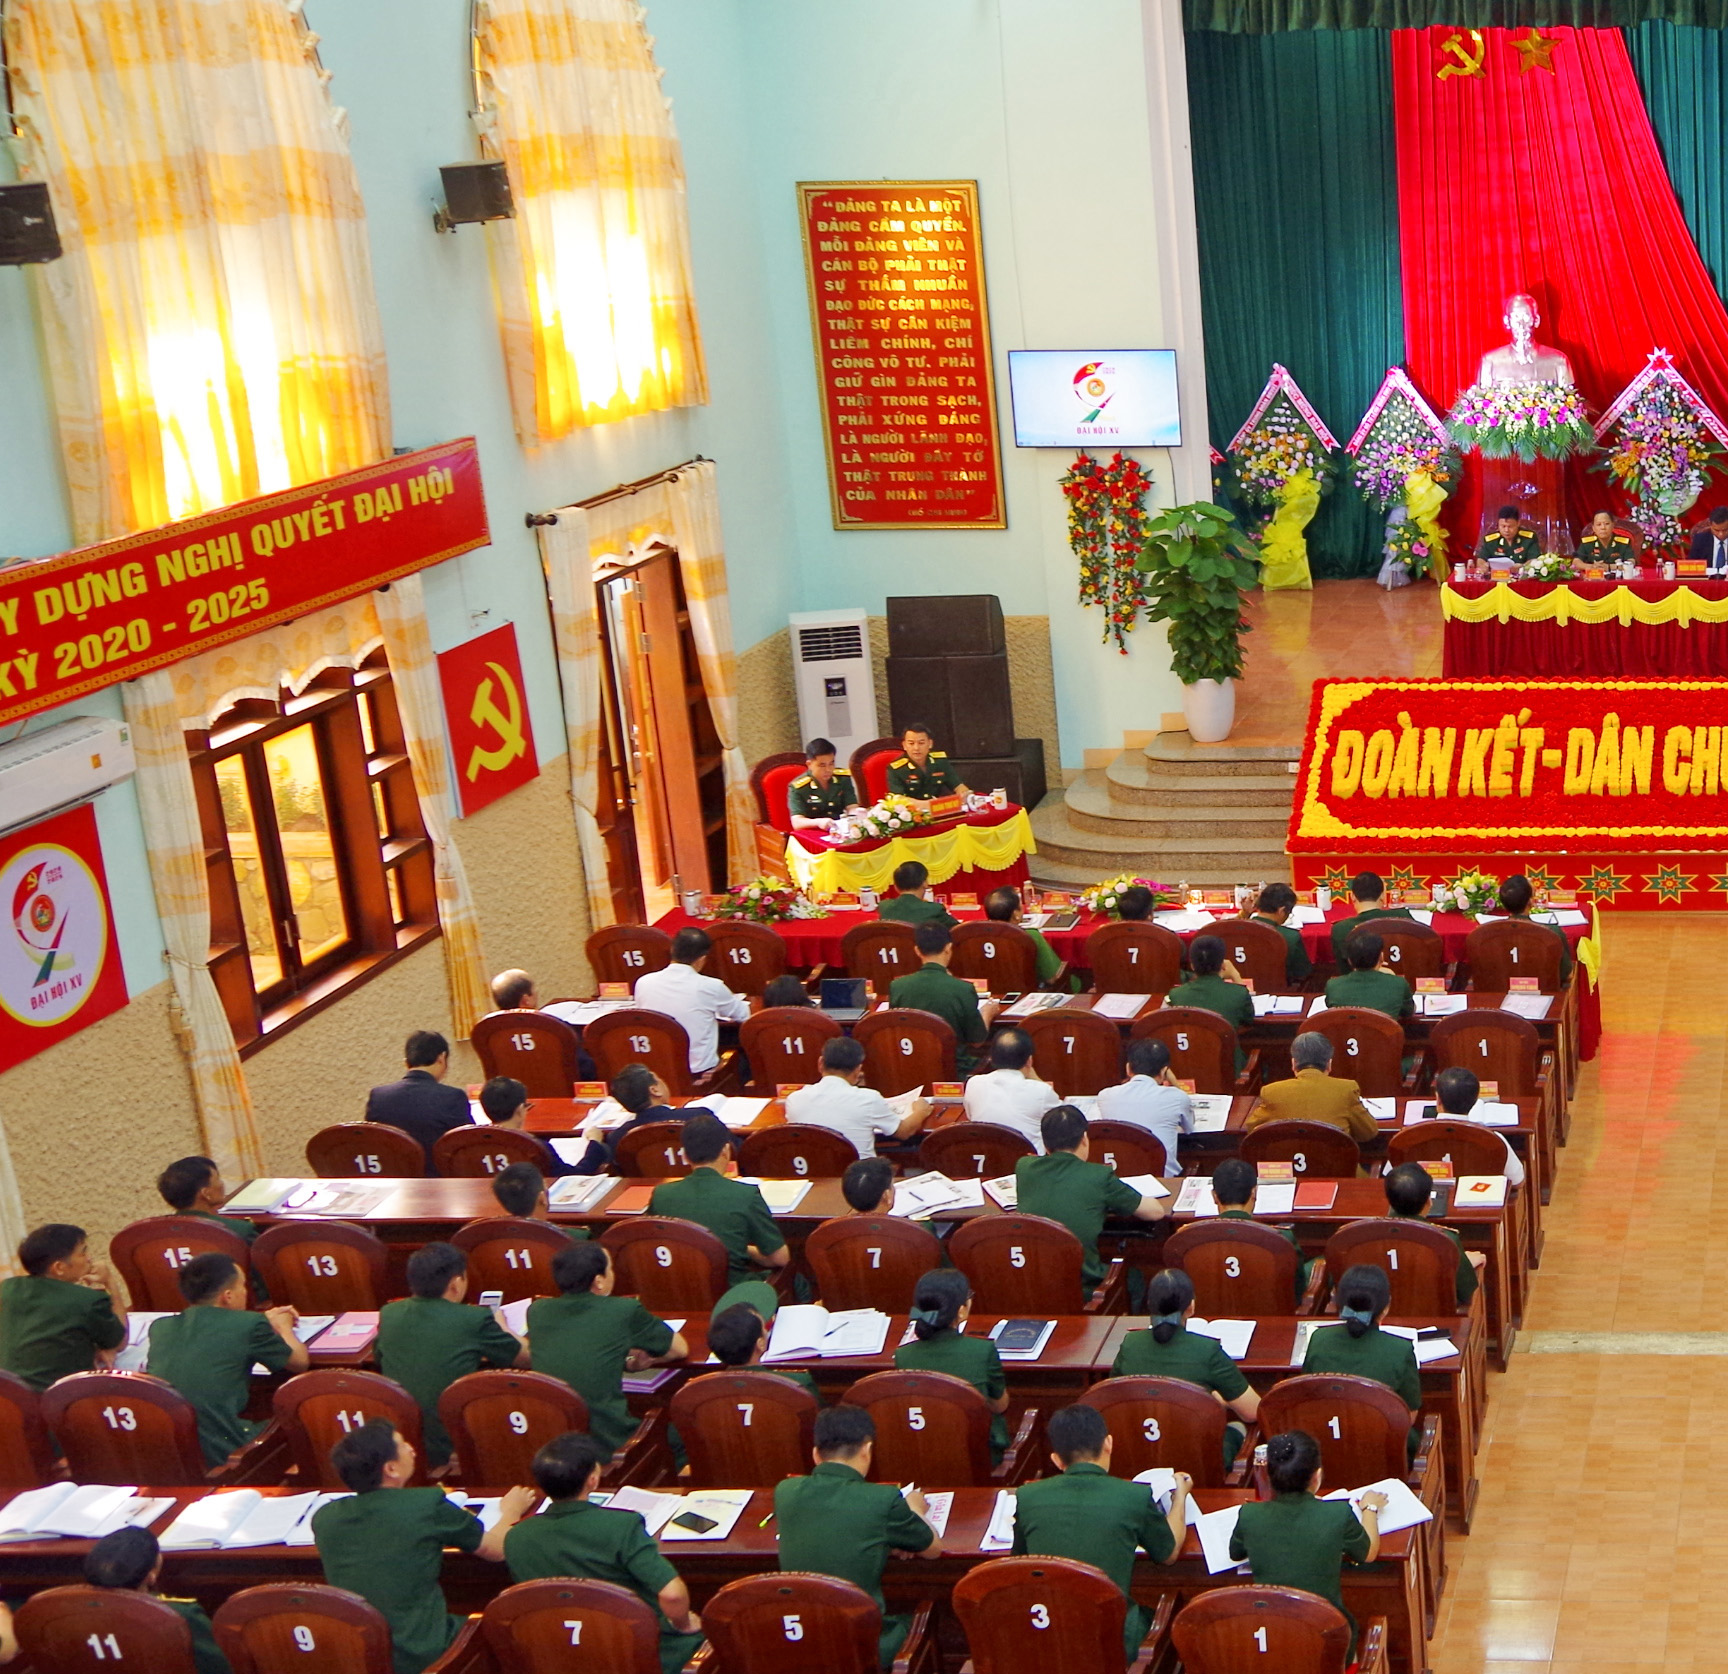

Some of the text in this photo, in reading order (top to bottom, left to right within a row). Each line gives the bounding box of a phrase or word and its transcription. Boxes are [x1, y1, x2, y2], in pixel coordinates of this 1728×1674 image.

[881, 200, 902, 212] TA
[906, 197, 926, 212] LÀ
[817, 217, 861, 232] ĐẢNG
[858, 257, 879, 274] BỘ
[927, 257, 967, 273] THẬT
[832, 355, 874, 368] CÔNG
[879, 355, 899, 368] VÔ
[939, 353, 975, 368] PHẢI
[834, 372, 976, 387] GIỮ GÌN ĐẢNG TA
[838, 411, 981, 425] PHẢI XỨNG ĐÁNG
[34, 562, 148, 626] DỰNG
[157, 532, 243, 587] NGHỊ
[252, 495, 346, 558] QUYẾT
[355, 485, 402, 527] ĐẠI
[409, 464, 454, 506] HỘI
[54, 618, 151, 679] 2020
[187, 578, 270, 633] 2025
[1331, 711, 1456, 799] ĐOÀN
[623, 951, 644, 966] 15
[879, 948, 898, 963] 11
[1128, 948, 1138, 963] 7
[1510, 947, 1517, 963] 1
[30, 991, 48, 1010] ĐẠI
[71, 974, 82, 990] XV
[512, 1034, 534, 1050] 15
[783, 1037, 804, 1054] 11
[1479, 1039, 1487, 1056] 1
[973, 1155, 985, 1172] 7
[308, 1256, 337, 1276] 13
[1011, 1247, 1025, 1267] 5
[1387, 1249, 1397, 1269] 1
[1225, 1257, 1240, 1277] 3
[103, 1407, 136, 1430] 13
[1031, 1604, 1050, 1628] 3
[784, 1615, 803, 1640] 5
[88, 1634, 122, 1658] 11
[294, 1626, 315, 1651] 9
[1254, 1627, 1267, 1651] 1
